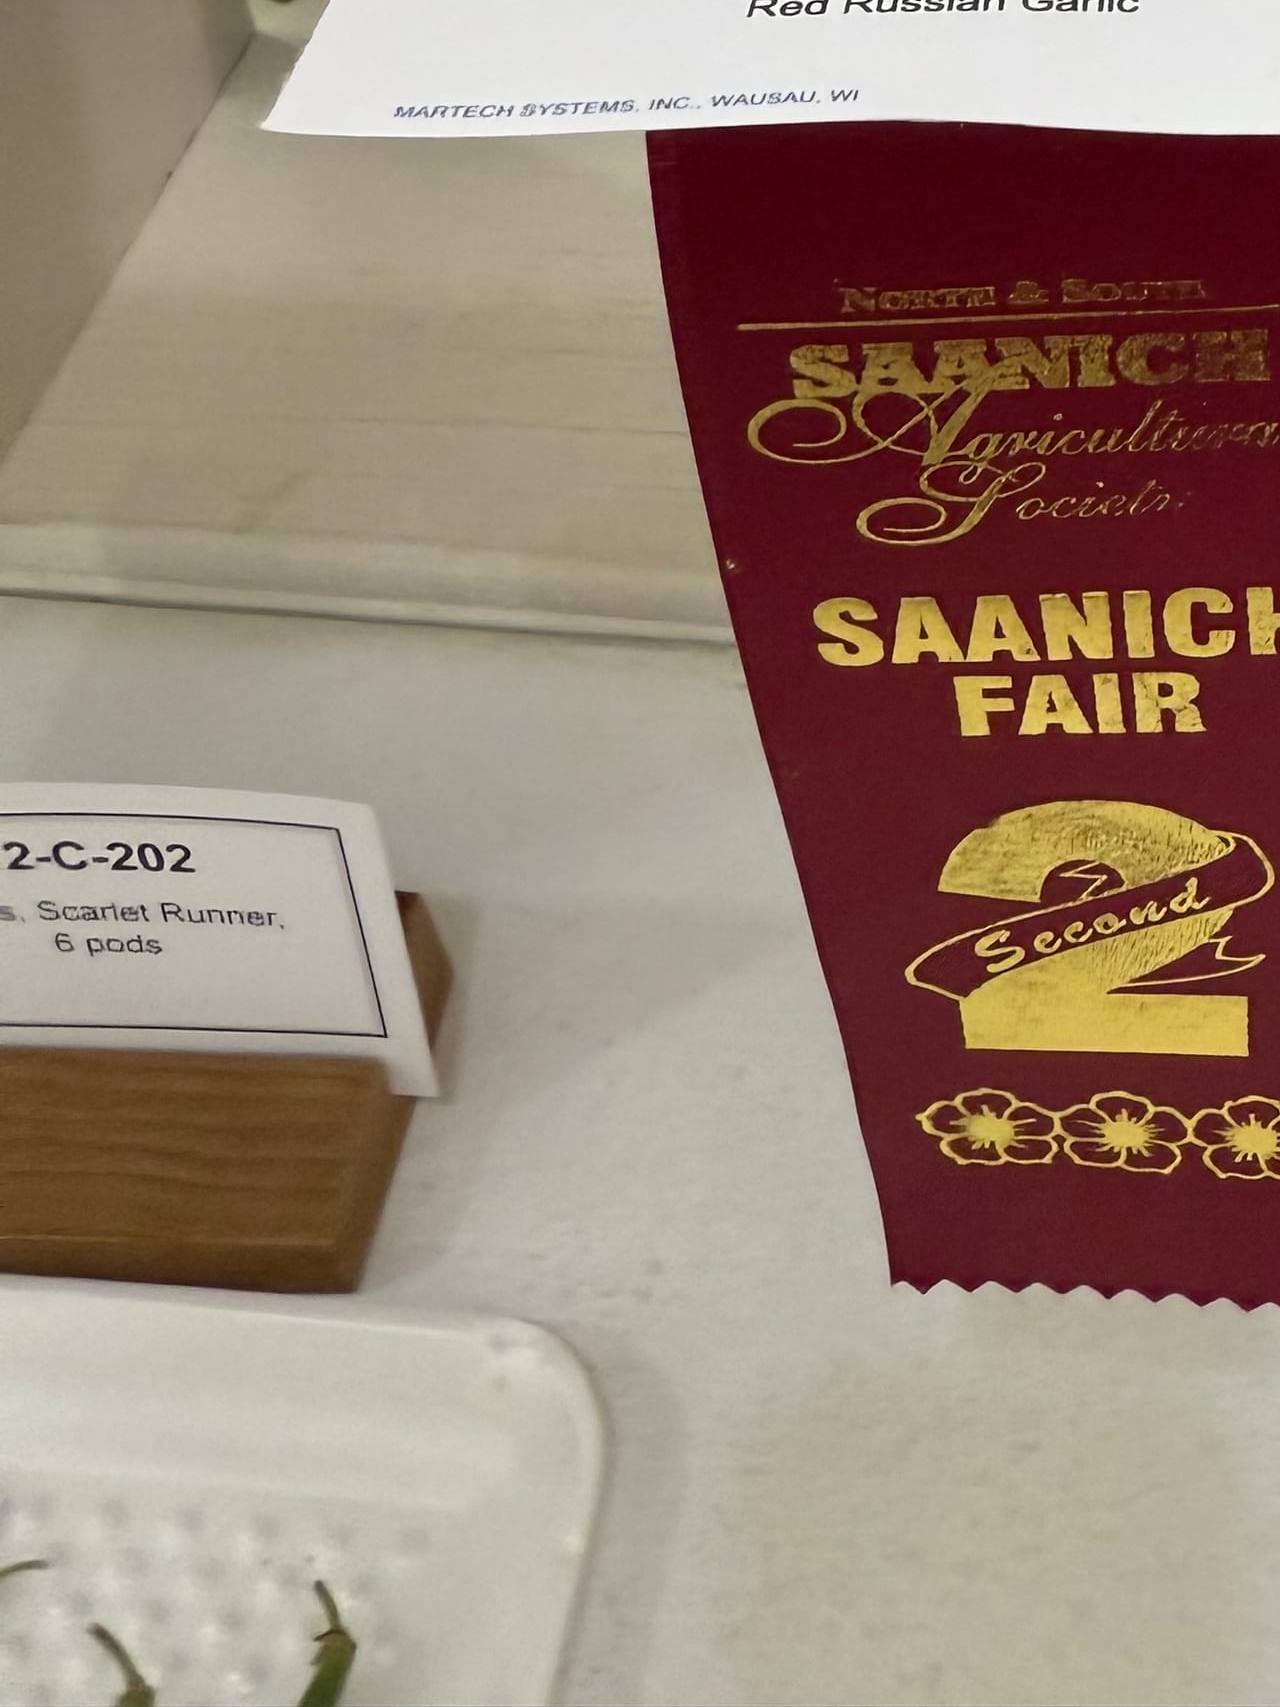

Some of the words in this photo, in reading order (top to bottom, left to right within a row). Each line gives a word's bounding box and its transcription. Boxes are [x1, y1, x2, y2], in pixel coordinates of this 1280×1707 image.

[394, 104, 514, 118] MARTECH
[830, 89, 860, 102] WI
[790, 329, 1271, 400] SAANICH
[953, 671, 1207, 737] FAIR
[37, 900, 150, 923] Scarlet
[160, 902, 285, 930] Runner,
[55, 932, 75, 954] 6
[86, 934, 163, 957] pods
[937, 799, 1249, 1057] 2
[974, 876, 1209, 973] Second
